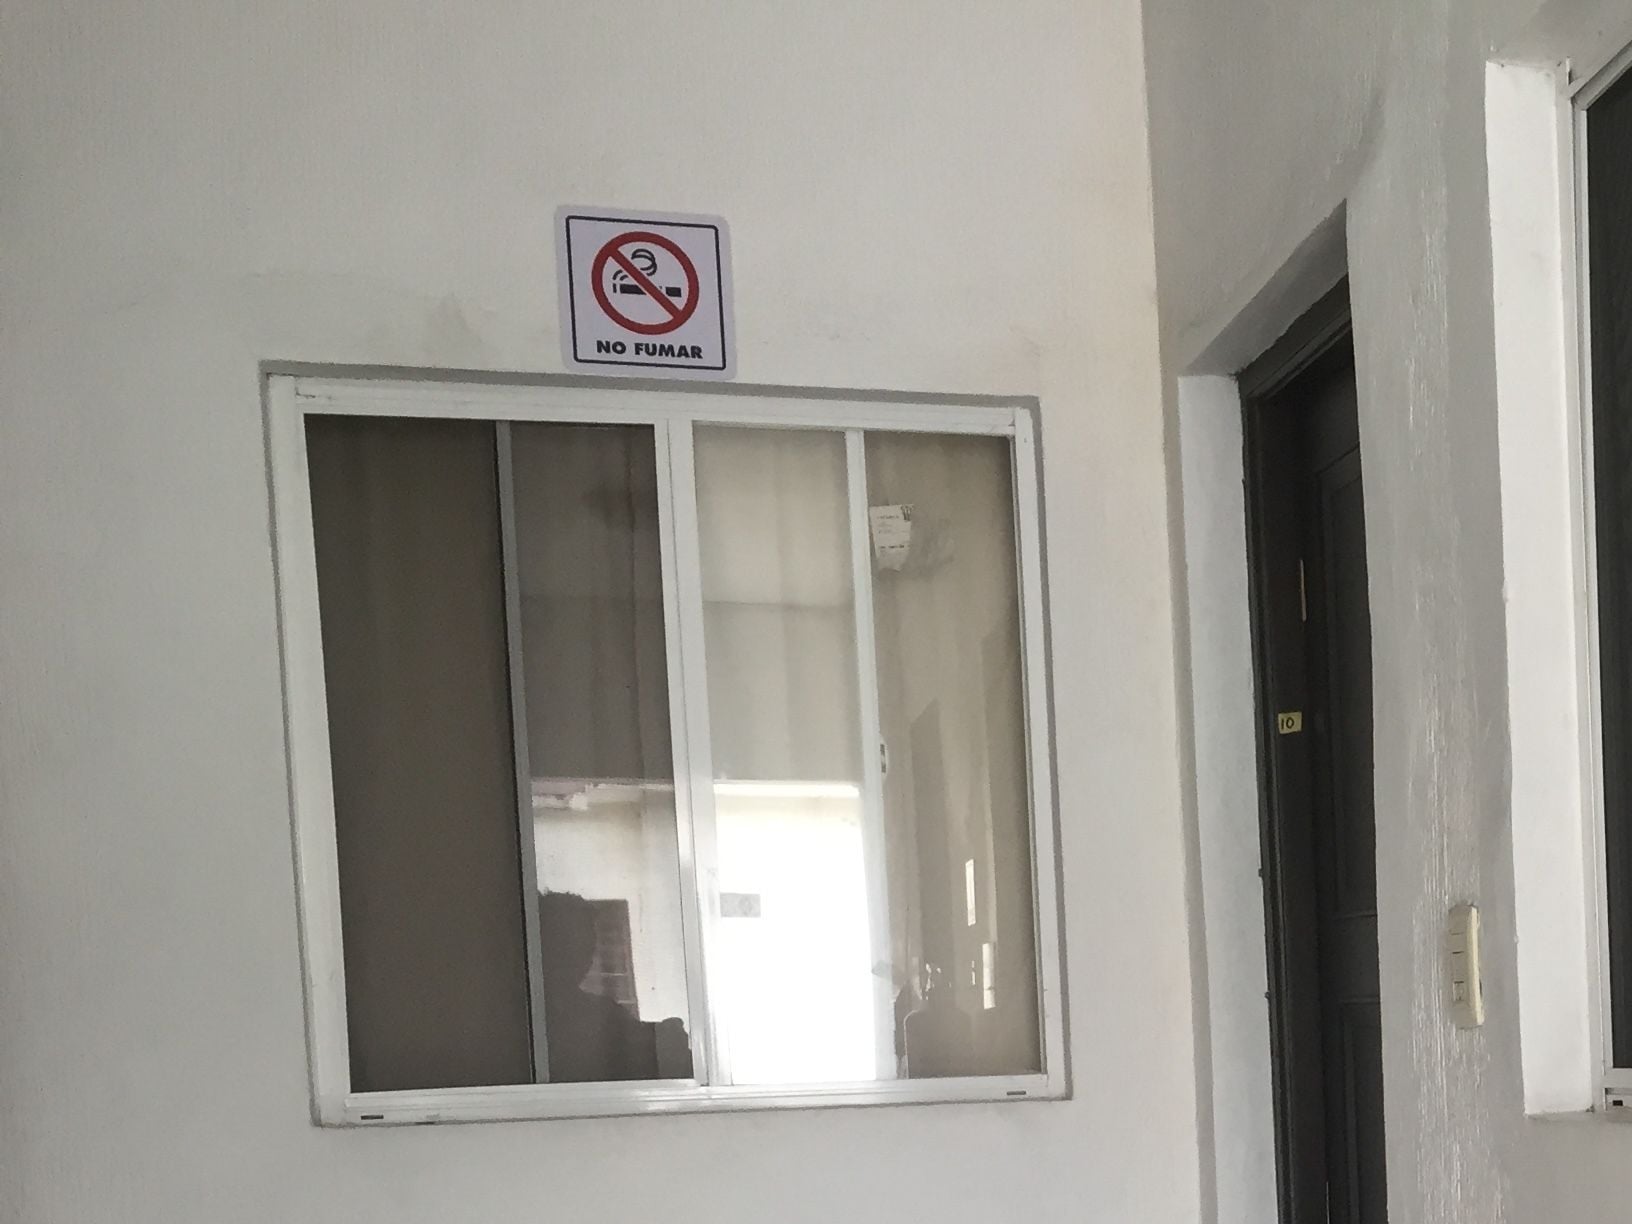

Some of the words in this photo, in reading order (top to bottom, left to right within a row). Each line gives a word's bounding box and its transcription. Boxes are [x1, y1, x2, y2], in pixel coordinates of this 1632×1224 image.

[596, 340, 626, 355] NO
[634, 342, 703, 359] FUMAR
[1281, 716, 1295, 730] 10
